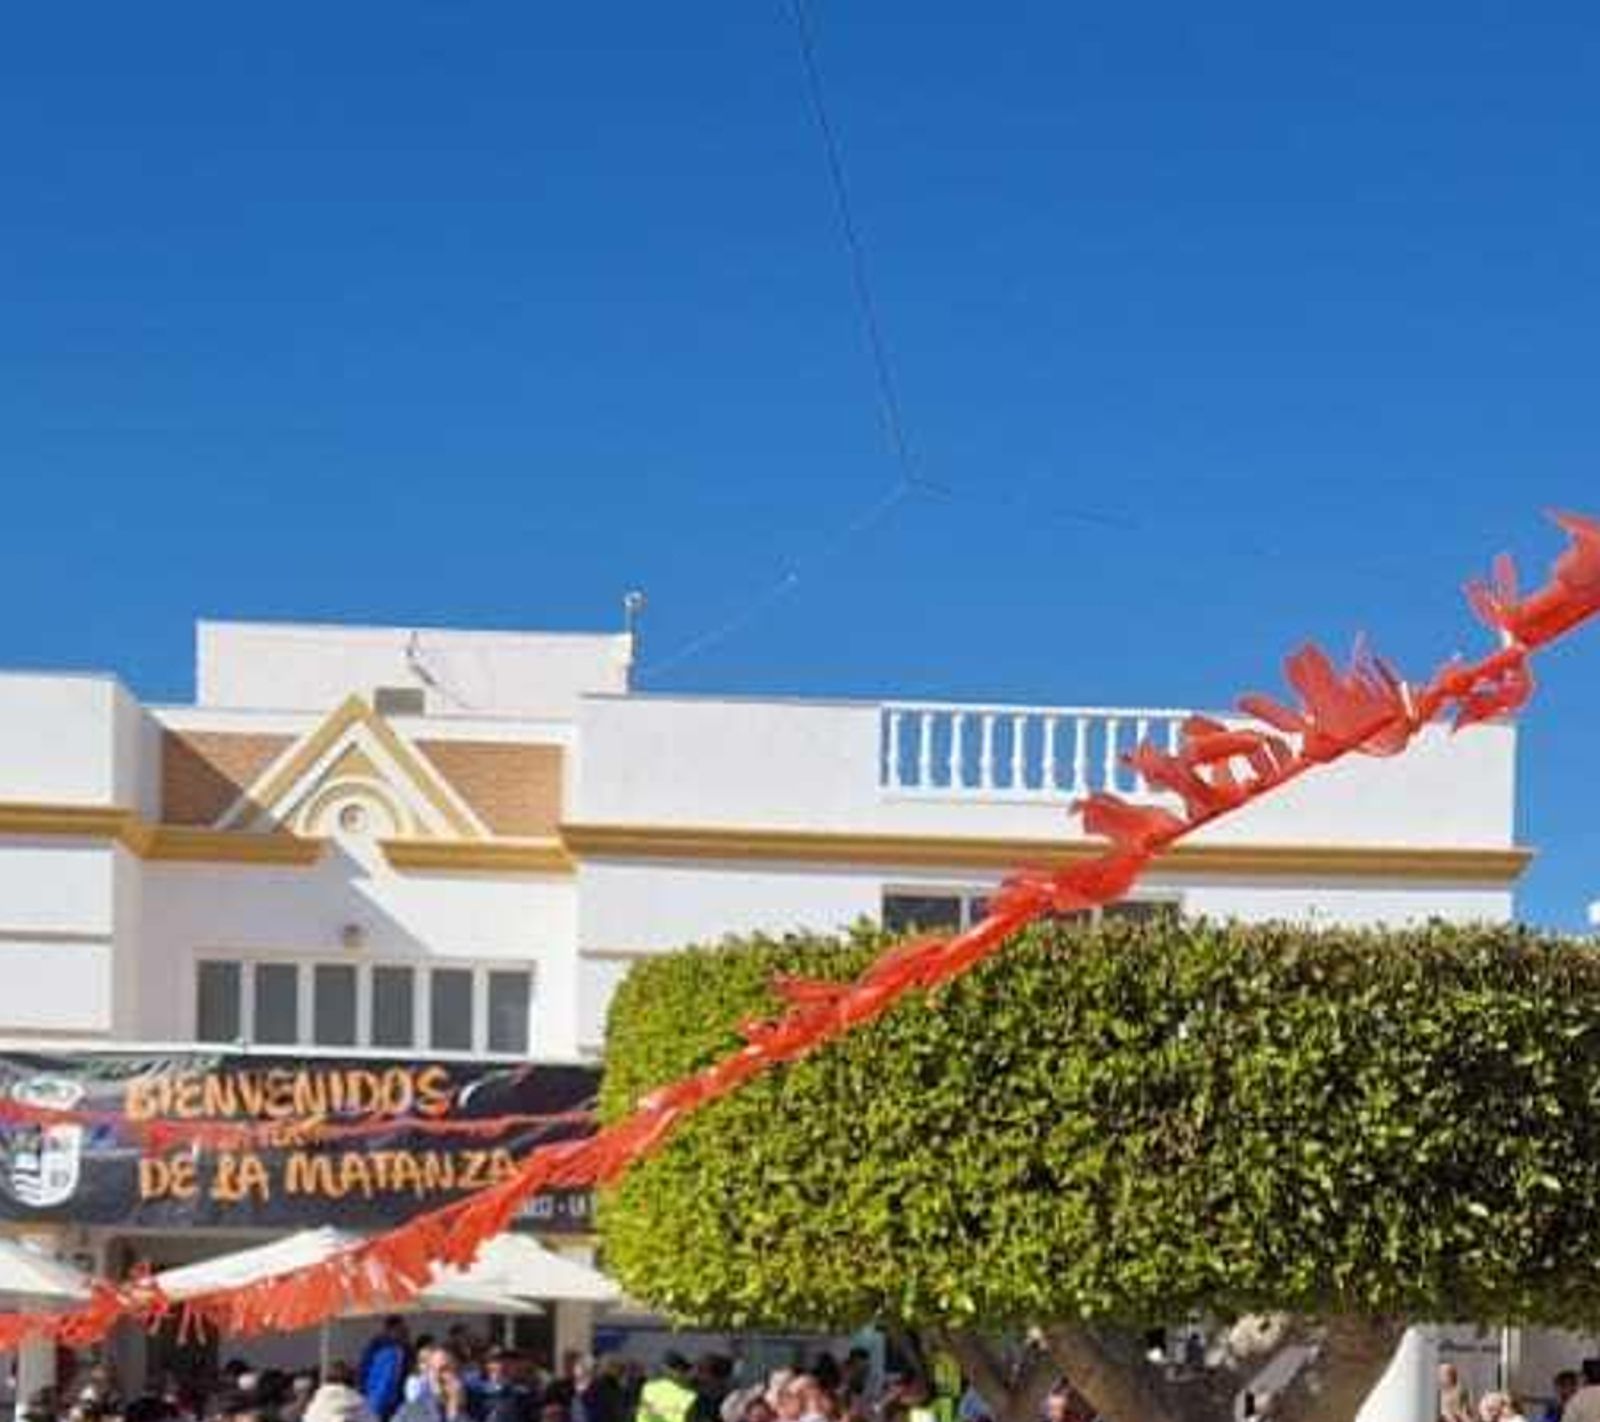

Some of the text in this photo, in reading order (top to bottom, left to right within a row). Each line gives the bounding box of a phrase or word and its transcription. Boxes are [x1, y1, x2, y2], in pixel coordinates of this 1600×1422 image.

[126, 1066, 451, 1121] BIENVENIDOS
[138, 1149, 522, 1202] DE LA MATANZA
